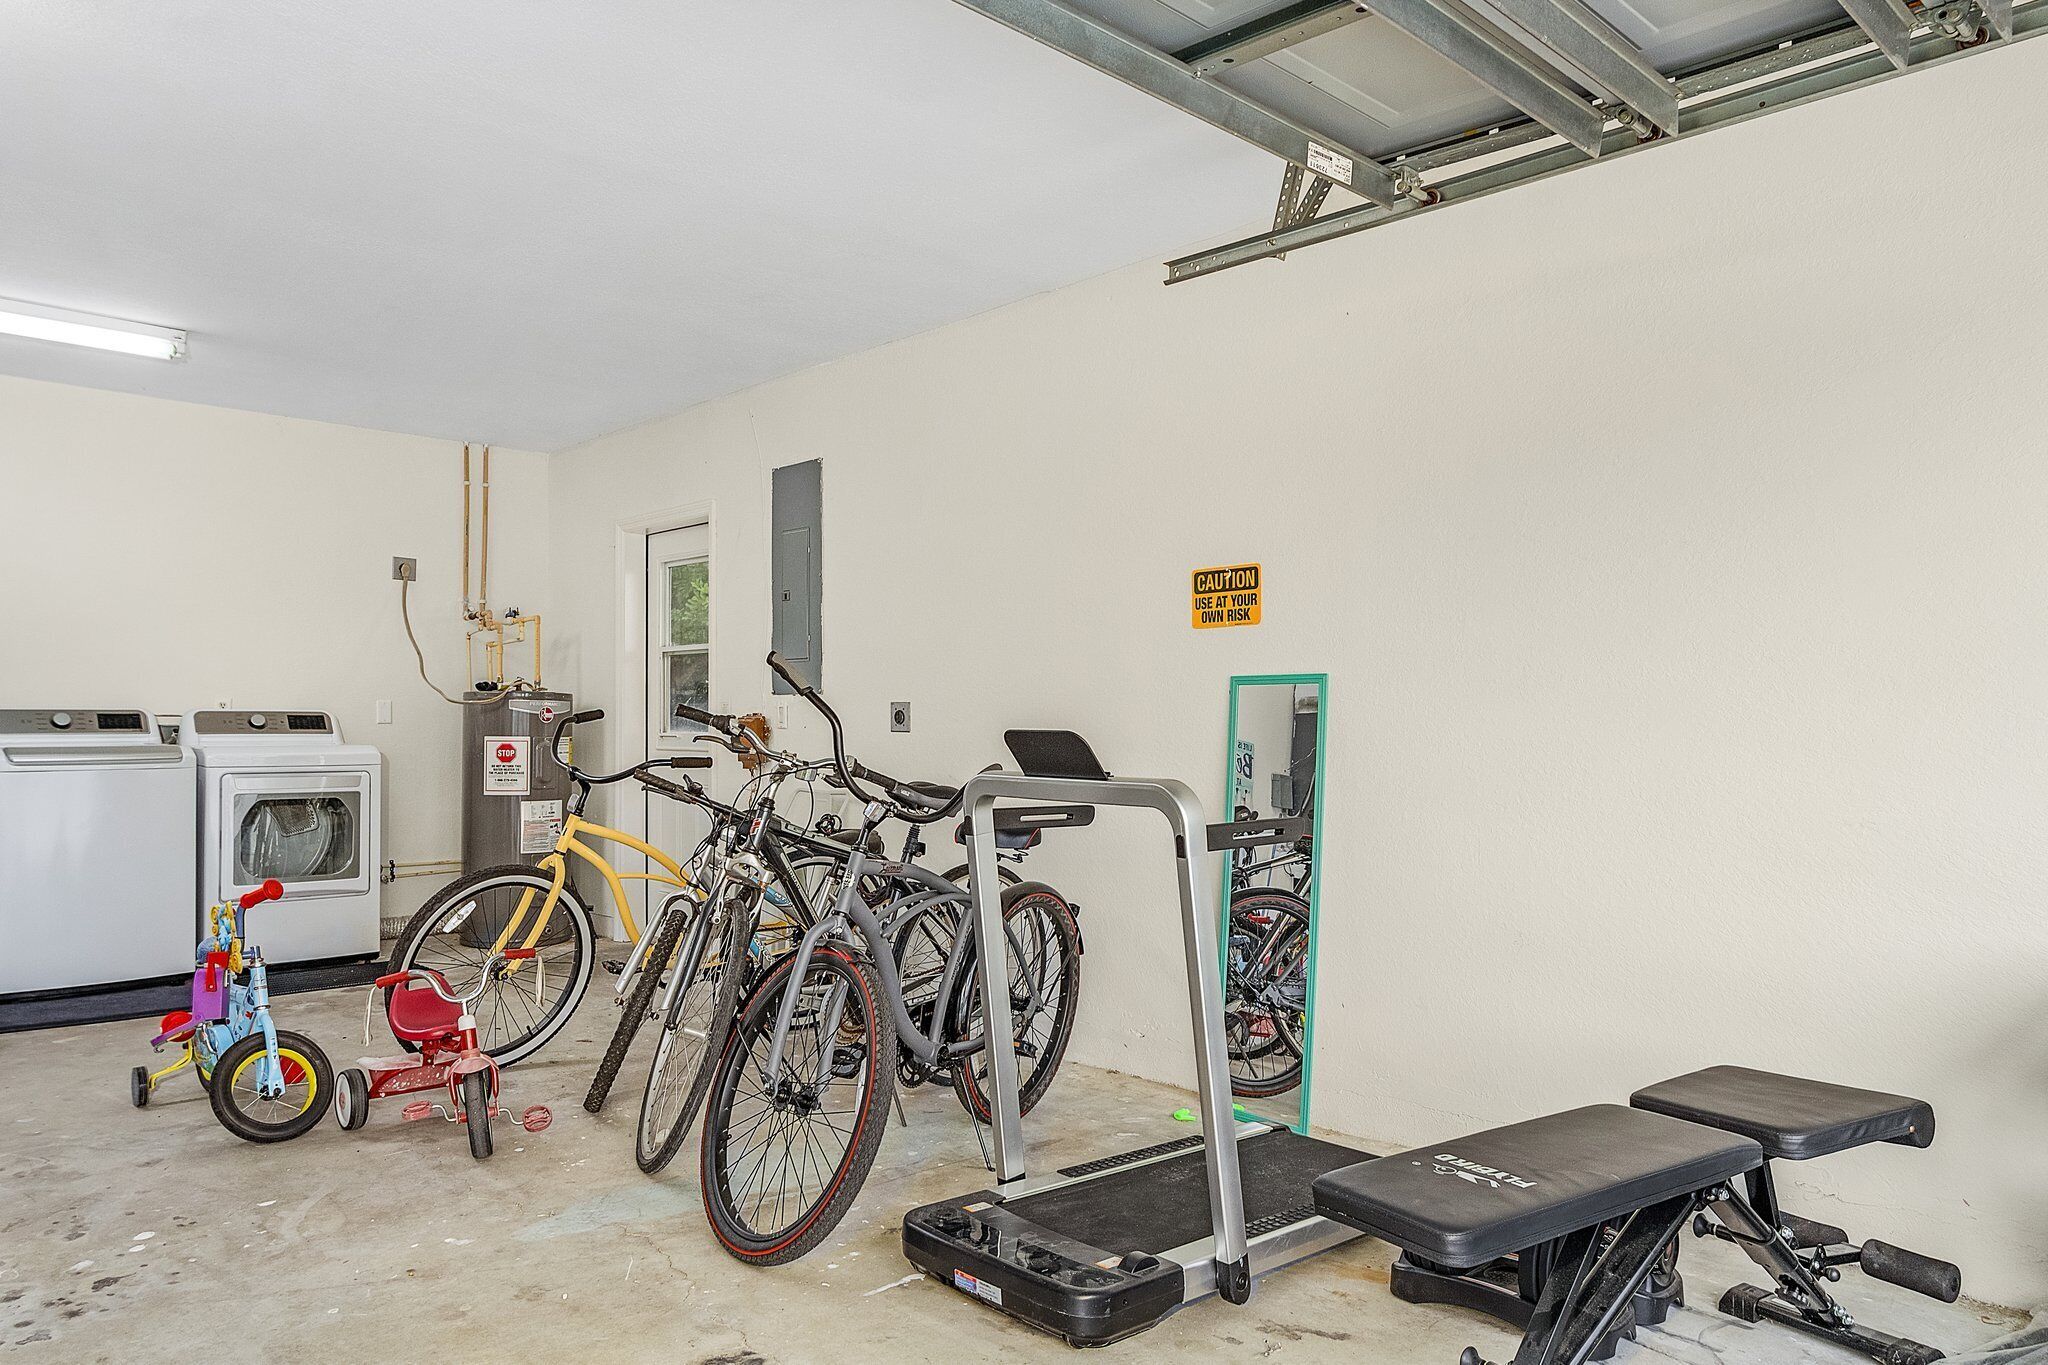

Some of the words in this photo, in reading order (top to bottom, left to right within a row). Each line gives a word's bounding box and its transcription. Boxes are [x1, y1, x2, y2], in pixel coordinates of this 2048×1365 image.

[1197, 570, 1255, 592] CAUTION
[1195, 597, 1213, 610] USE
[1215, 595, 1228, 609] AT
[1231, 593, 1257, 607] YOUR
[1201, 610, 1224, 624] OWN
[1227, 607, 1251, 622] RISK
[1434, 1153, 1538, 1189] FLYBIRD
